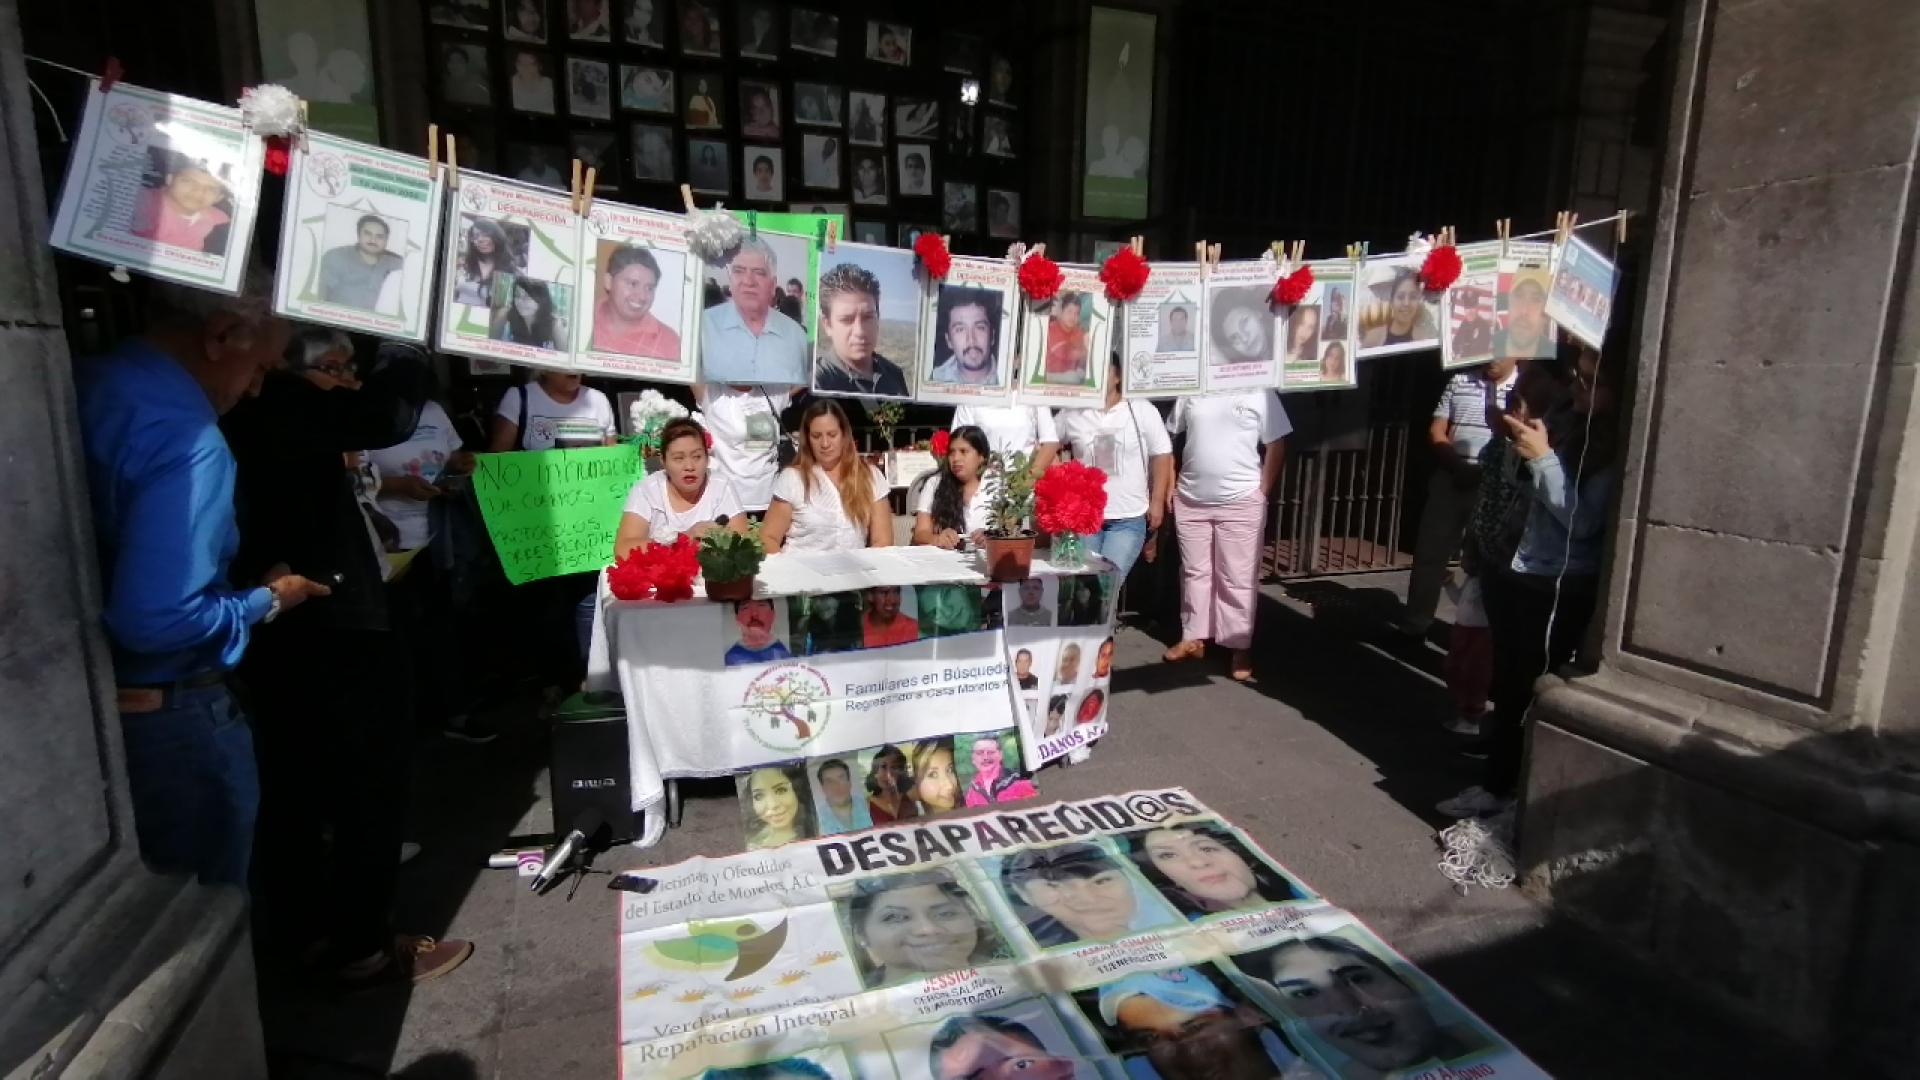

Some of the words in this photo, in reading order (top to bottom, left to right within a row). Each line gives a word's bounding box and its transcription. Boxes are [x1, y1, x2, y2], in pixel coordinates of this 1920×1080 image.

[497, 202, 566, 224] DESAPARECIDA
[480, 457, 521, 491] NO
[845, 676, 919, 697] Familiares
[921, 671, 939, 685] en
[943, 661, 1010, 683] Búsqueda
[845, 692, 913, 712] Regresando
[915, 691, 922, 700] a
[926, 687, 955, 698] Casa
[958, 680, 1001, 694] Morelos
[816, 791, 1202, 878] DESAPARECID@S
[649, 871, 709, 893] ictimas
[711, 872, 721, 887] y
[722, 857, 793, 880] Ofendidos
[625, 905, 648, 920] del
[653, 891, 702, 916] Estado
[707, 890, 727, 904] de
[729, 880, 789, 900] Morelos,
[791, 872, 820, 890] A.C.
[923, 968, 979, 993] JESSICA
[640, 1022, 769, 1063] Reparación
[774, 1000, 858, 1033] Integral
